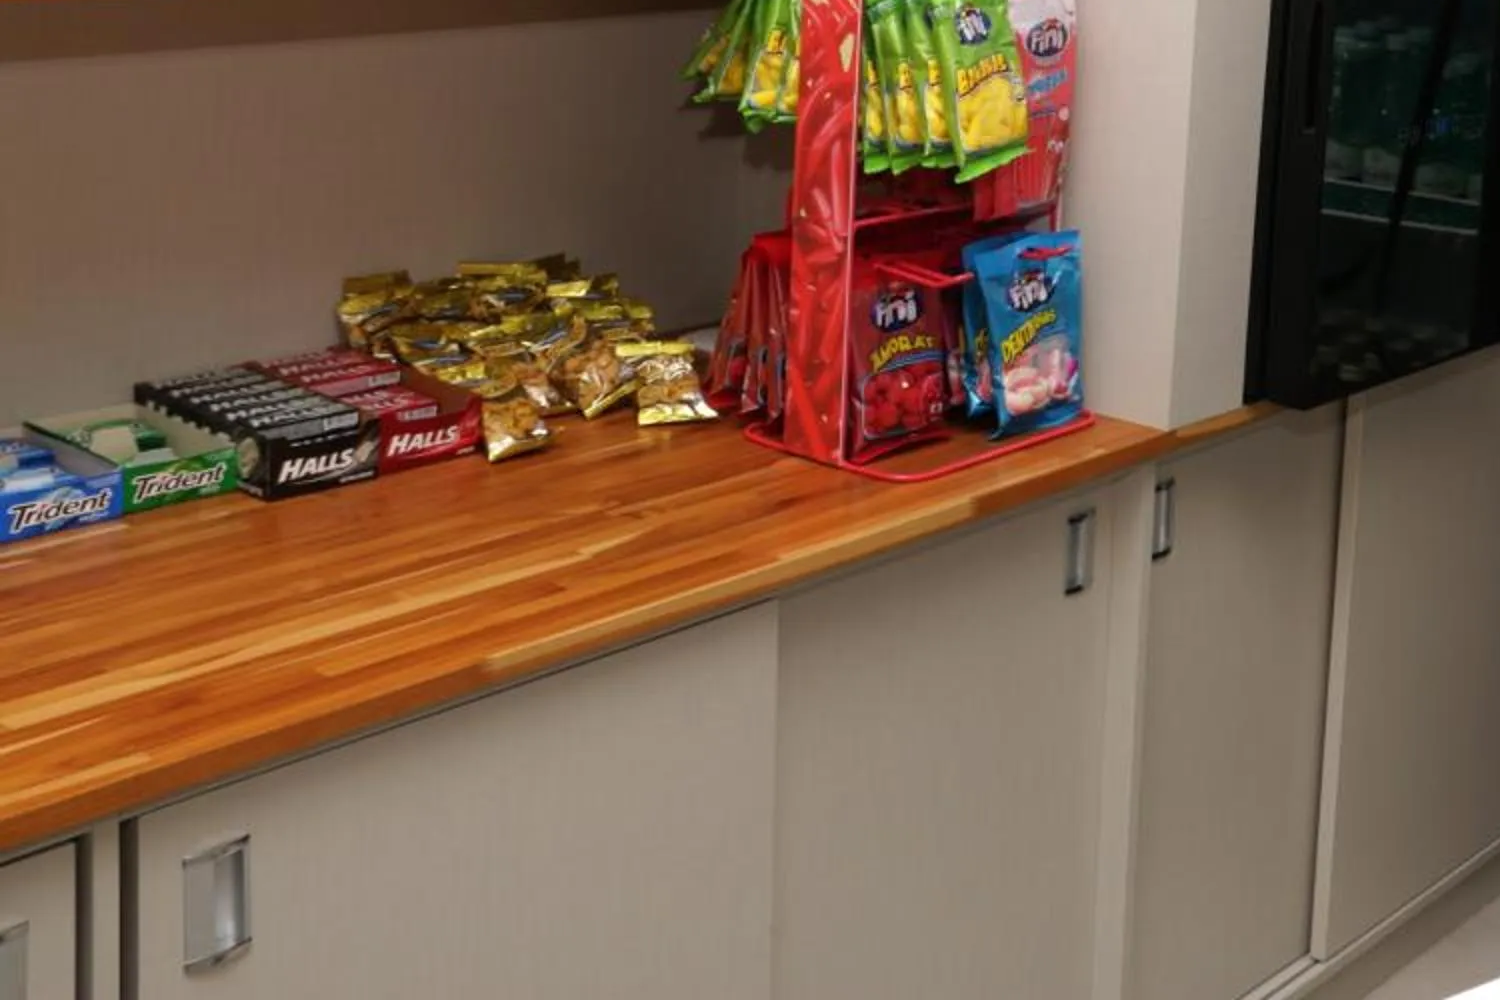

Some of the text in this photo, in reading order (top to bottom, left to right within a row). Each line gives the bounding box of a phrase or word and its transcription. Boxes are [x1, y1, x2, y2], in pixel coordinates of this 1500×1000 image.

[387, 423, 461, 458] HALLS
[131, 461, 227, 505] Trident
[277, 448, 355, 484] HALLS
[6, 487, 114, 535] Trident
